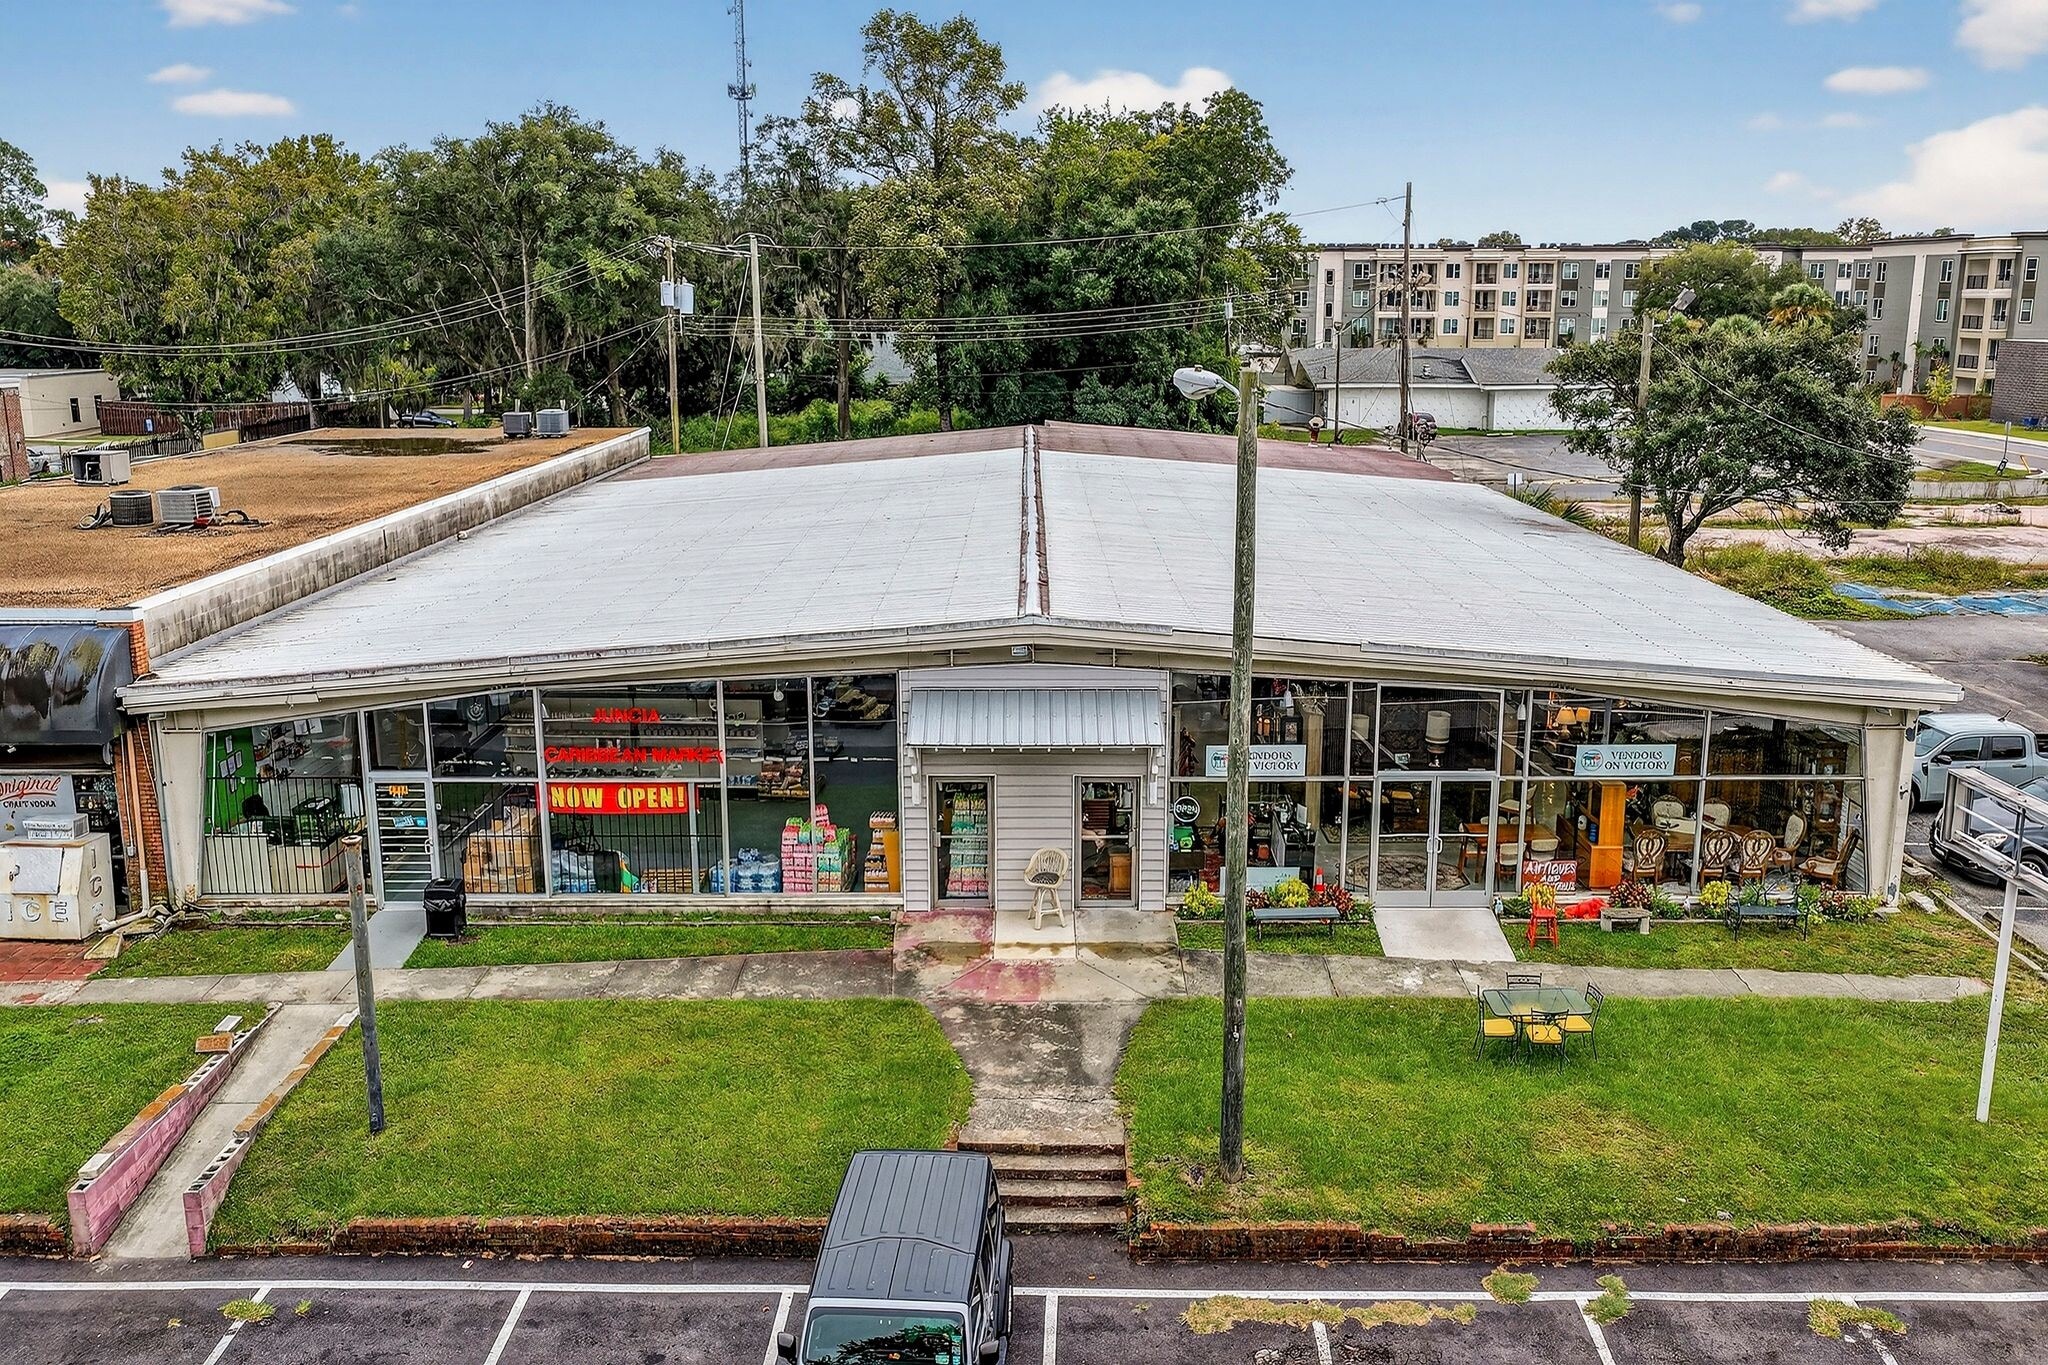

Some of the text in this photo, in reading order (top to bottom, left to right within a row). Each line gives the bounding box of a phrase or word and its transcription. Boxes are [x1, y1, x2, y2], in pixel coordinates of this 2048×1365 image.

[544, 746, 724, 764] CARIBBEAN MARKET
[1249, 751, 1292, 760] ENDORS
[1611, 751, 1663, 760] VENDORS
[1253, 761, 1301, 770] VICTORY
[1604, 761, 1670, 770] ON VICTORY
[550, 786, 685, 809] NOW OPEN!
[4, 900, 69, 922] ICE
